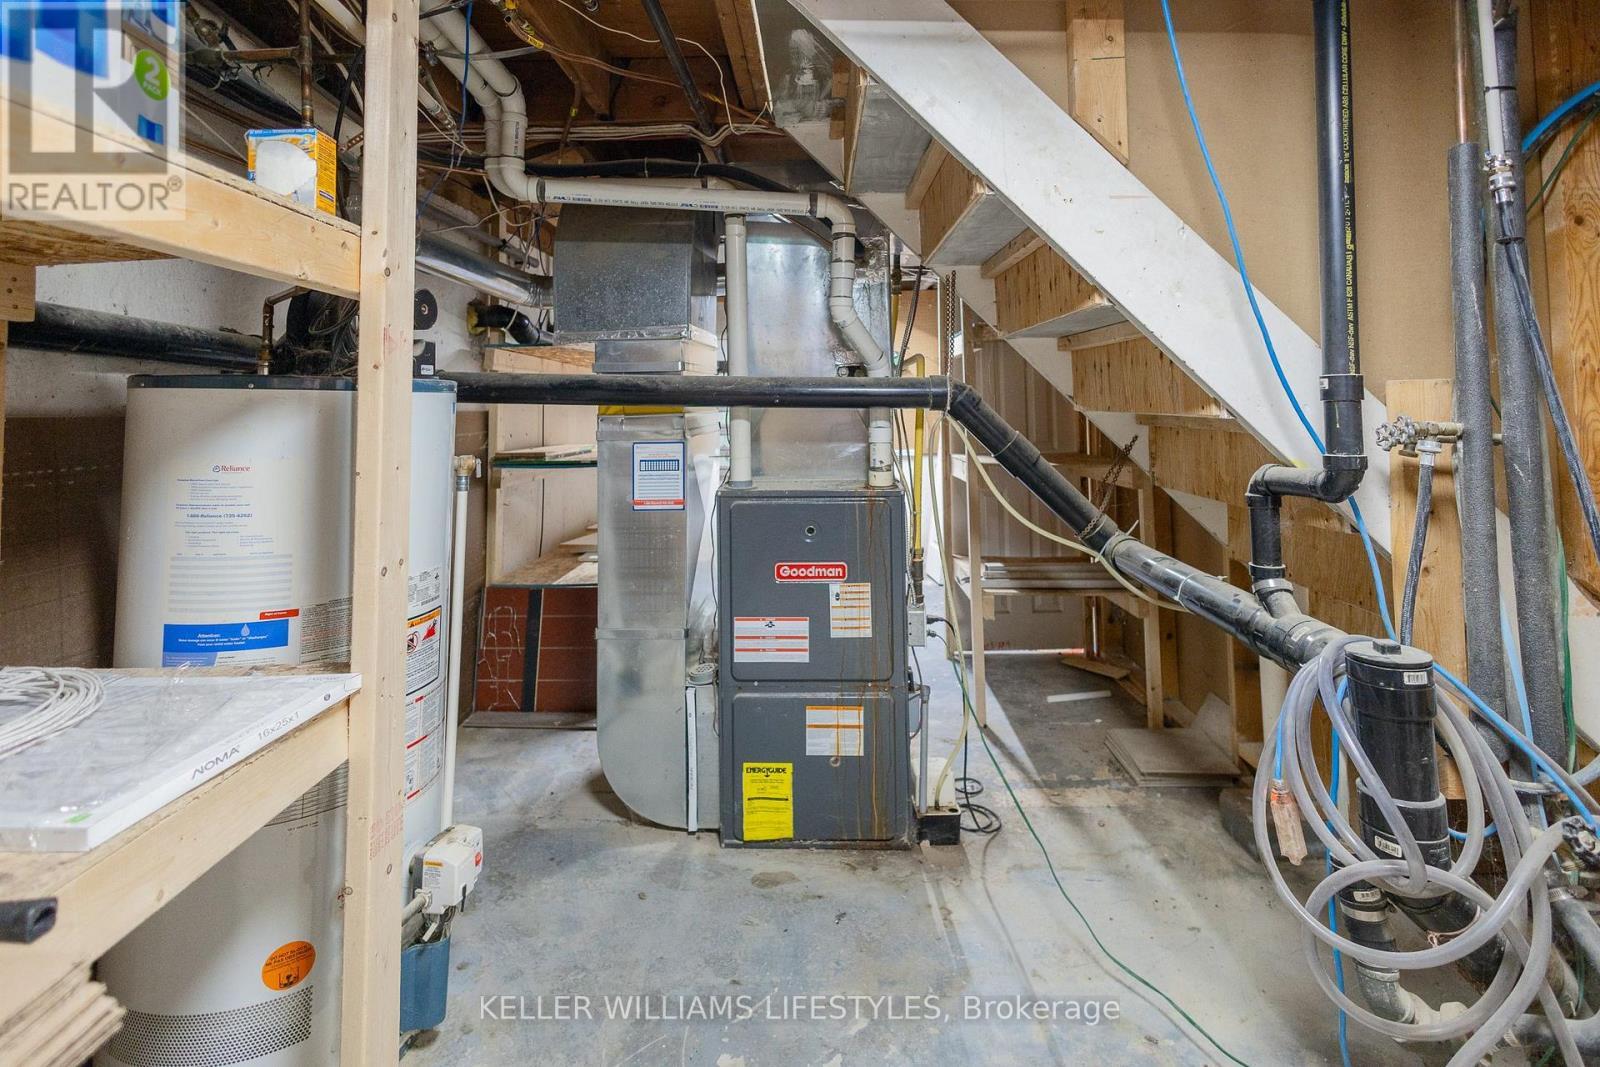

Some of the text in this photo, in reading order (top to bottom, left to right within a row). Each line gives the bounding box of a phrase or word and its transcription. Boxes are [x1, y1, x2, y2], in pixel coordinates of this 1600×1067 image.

[144, 56, 160, 85] 2
[221, 464, 251, 472] Reliance
[779, 566, 843, 577] Goodman
[191, 747, 239, 780] NOMA
[258, 711, 300, 740] 16x25x1
[746, 767, 787, 775] ENERGYGUIDE
